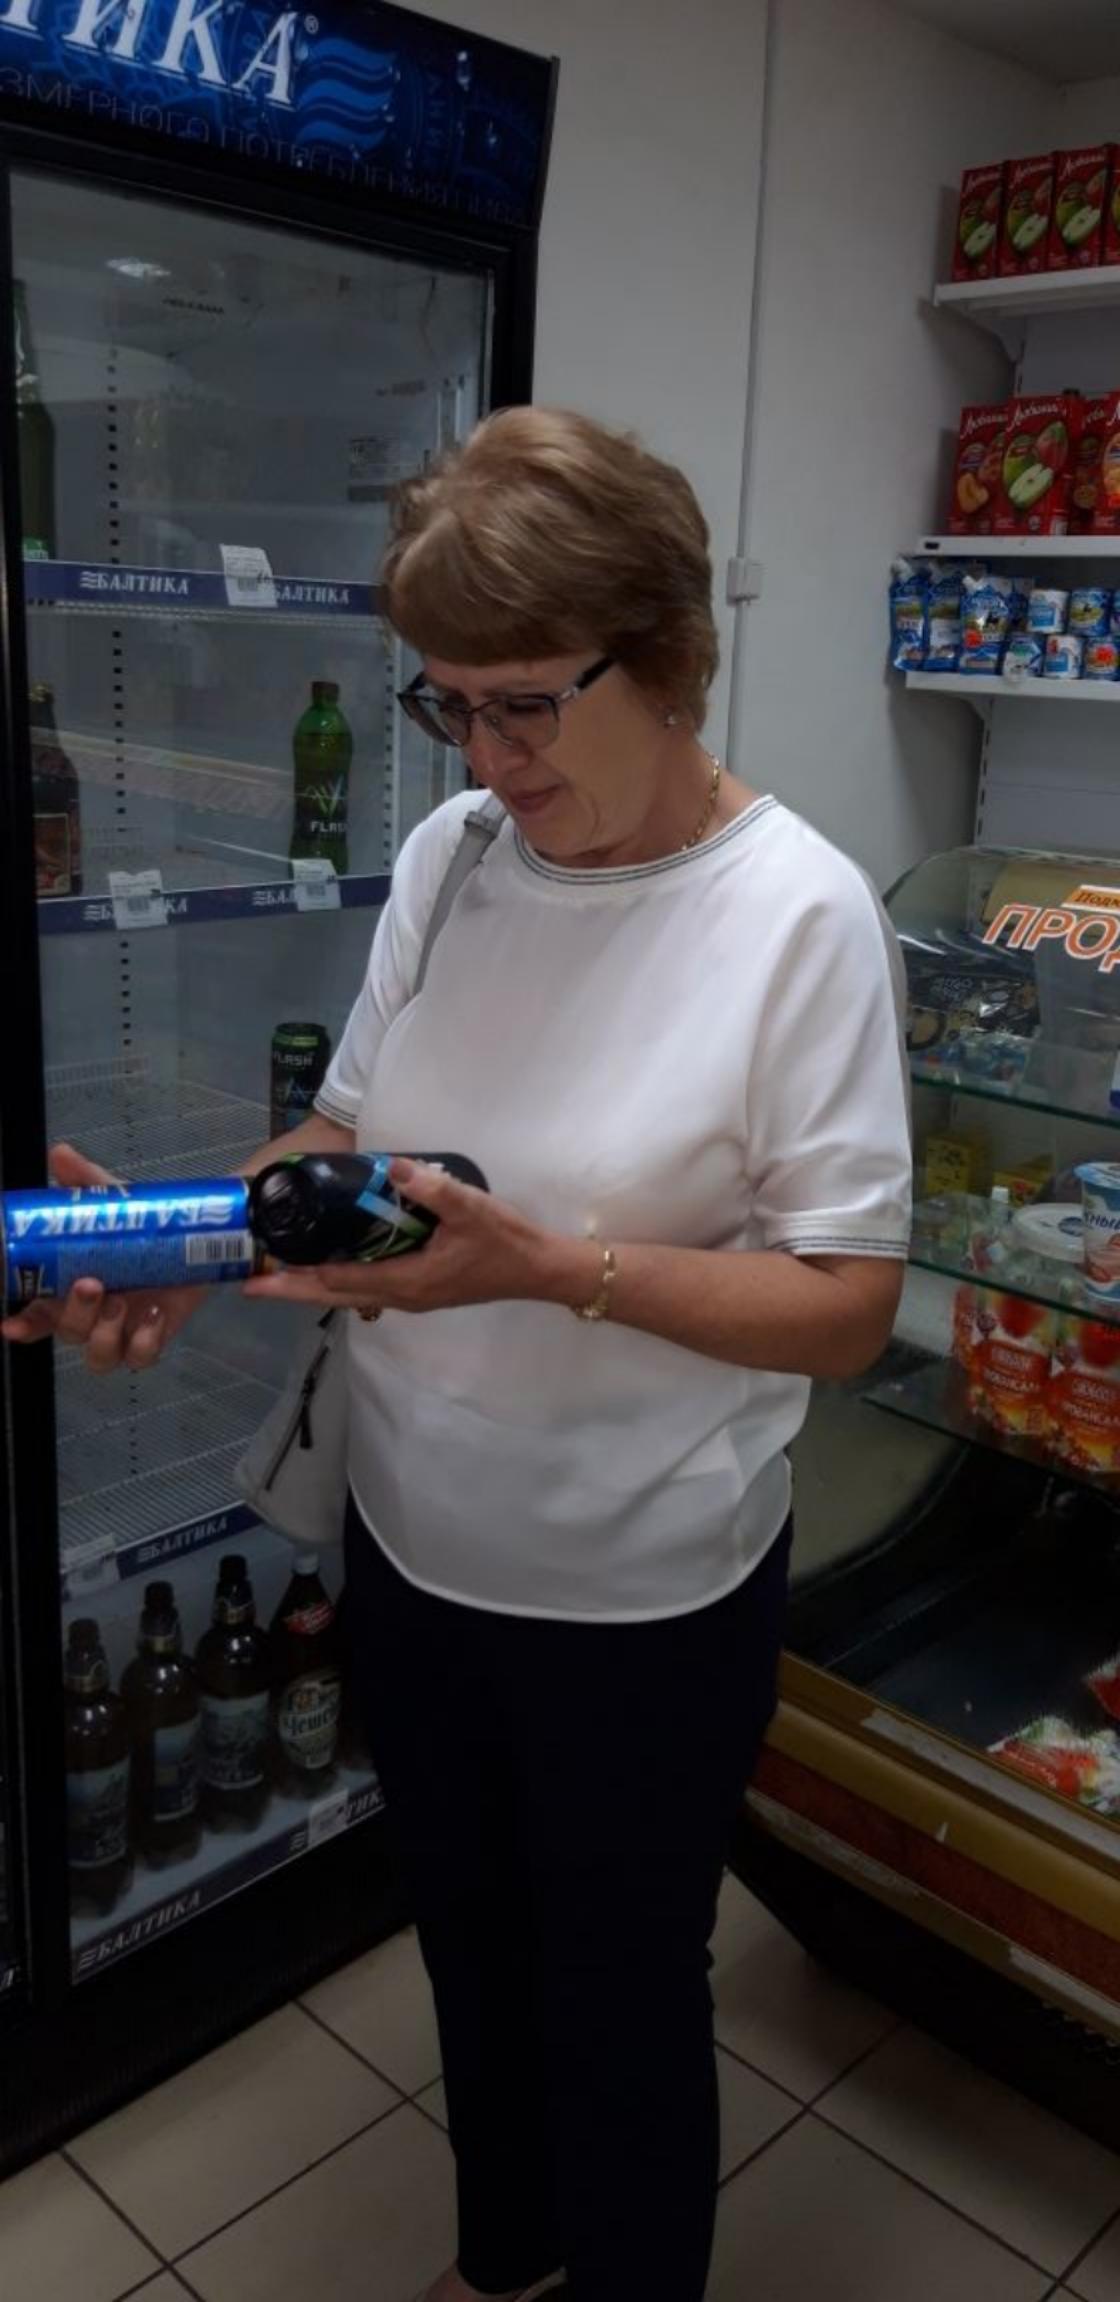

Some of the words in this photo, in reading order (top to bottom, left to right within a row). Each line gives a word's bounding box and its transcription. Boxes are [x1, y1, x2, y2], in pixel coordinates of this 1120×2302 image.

[96, 573, 189, 596] БАЛТИКА
[11, 1199, 200, 1237] БАЛТИКА
[97, 1890, 200, 1961] БАЛТИКА
